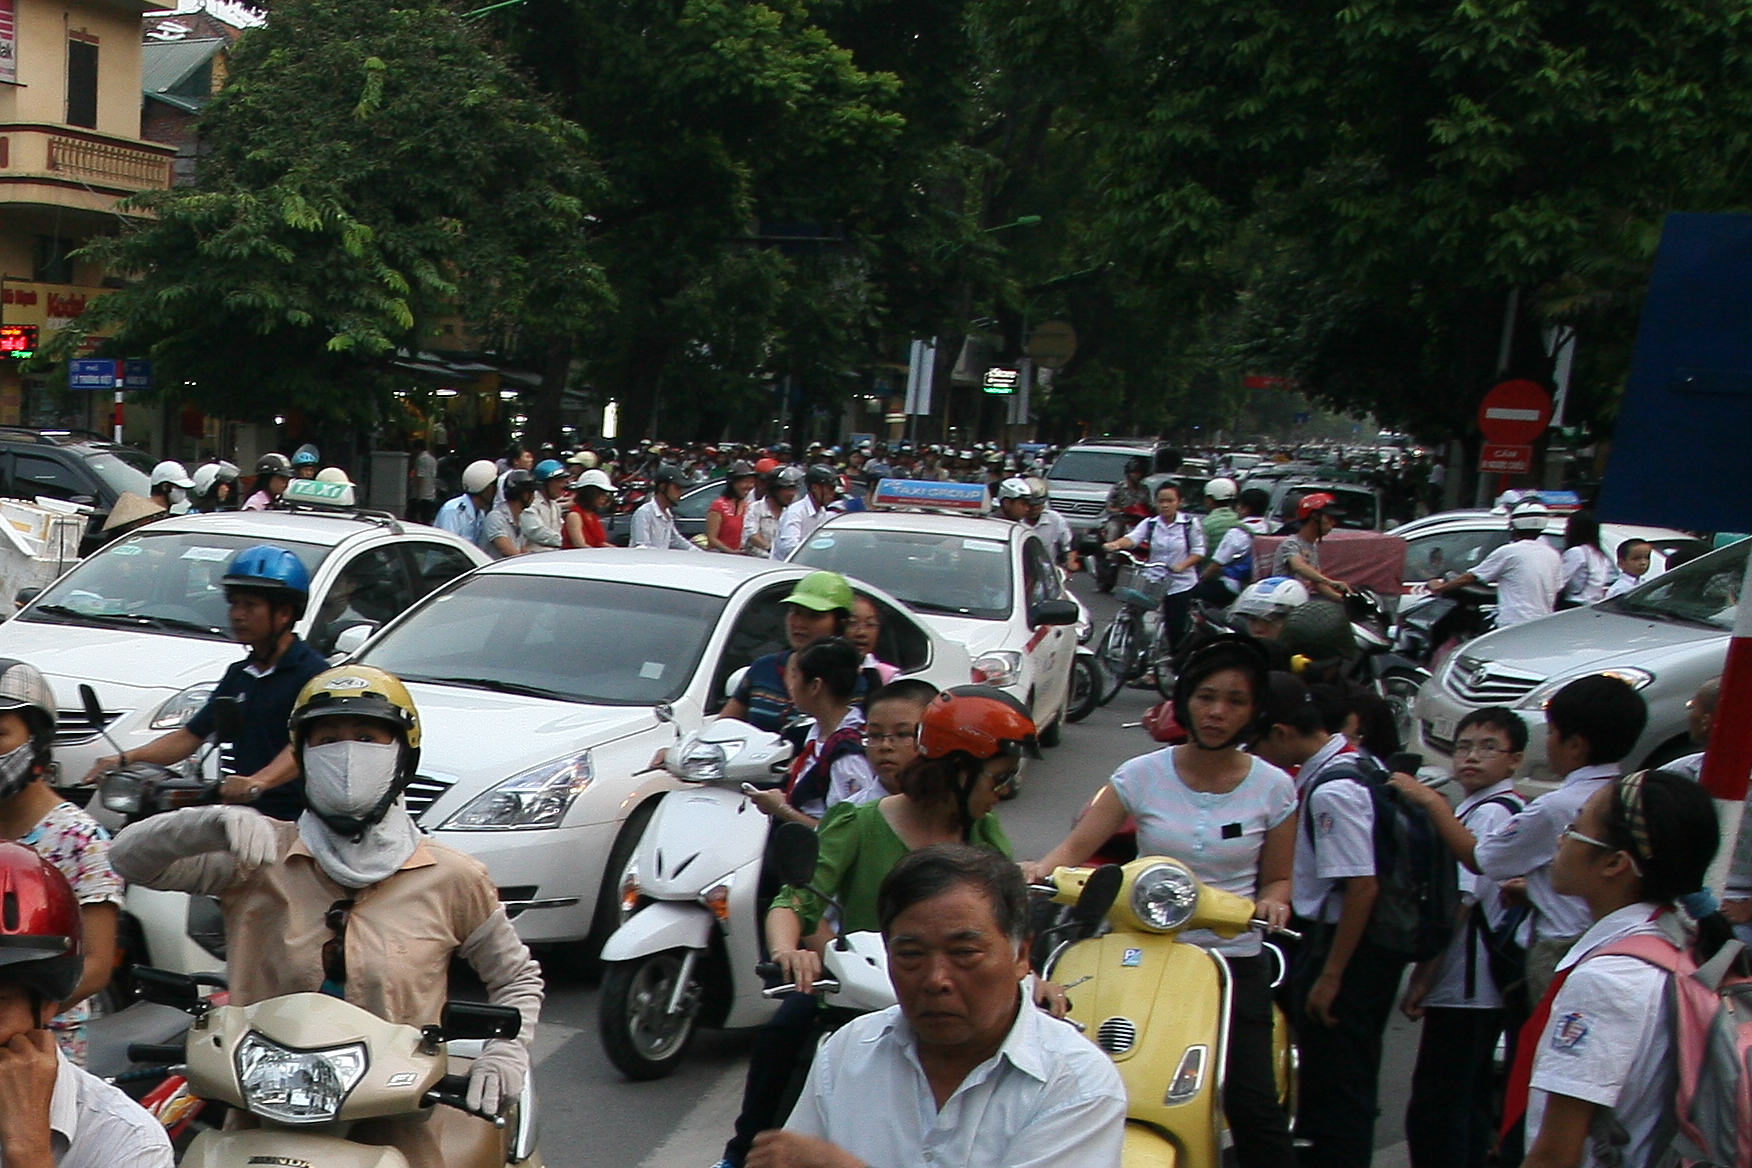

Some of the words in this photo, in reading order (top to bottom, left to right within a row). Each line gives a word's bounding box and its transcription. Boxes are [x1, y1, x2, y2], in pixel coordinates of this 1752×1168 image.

[295, 482, 341, 497] TAXI
[892, 485, 926, 496] TAXI
[928, 487, 981, 499] GROUP
